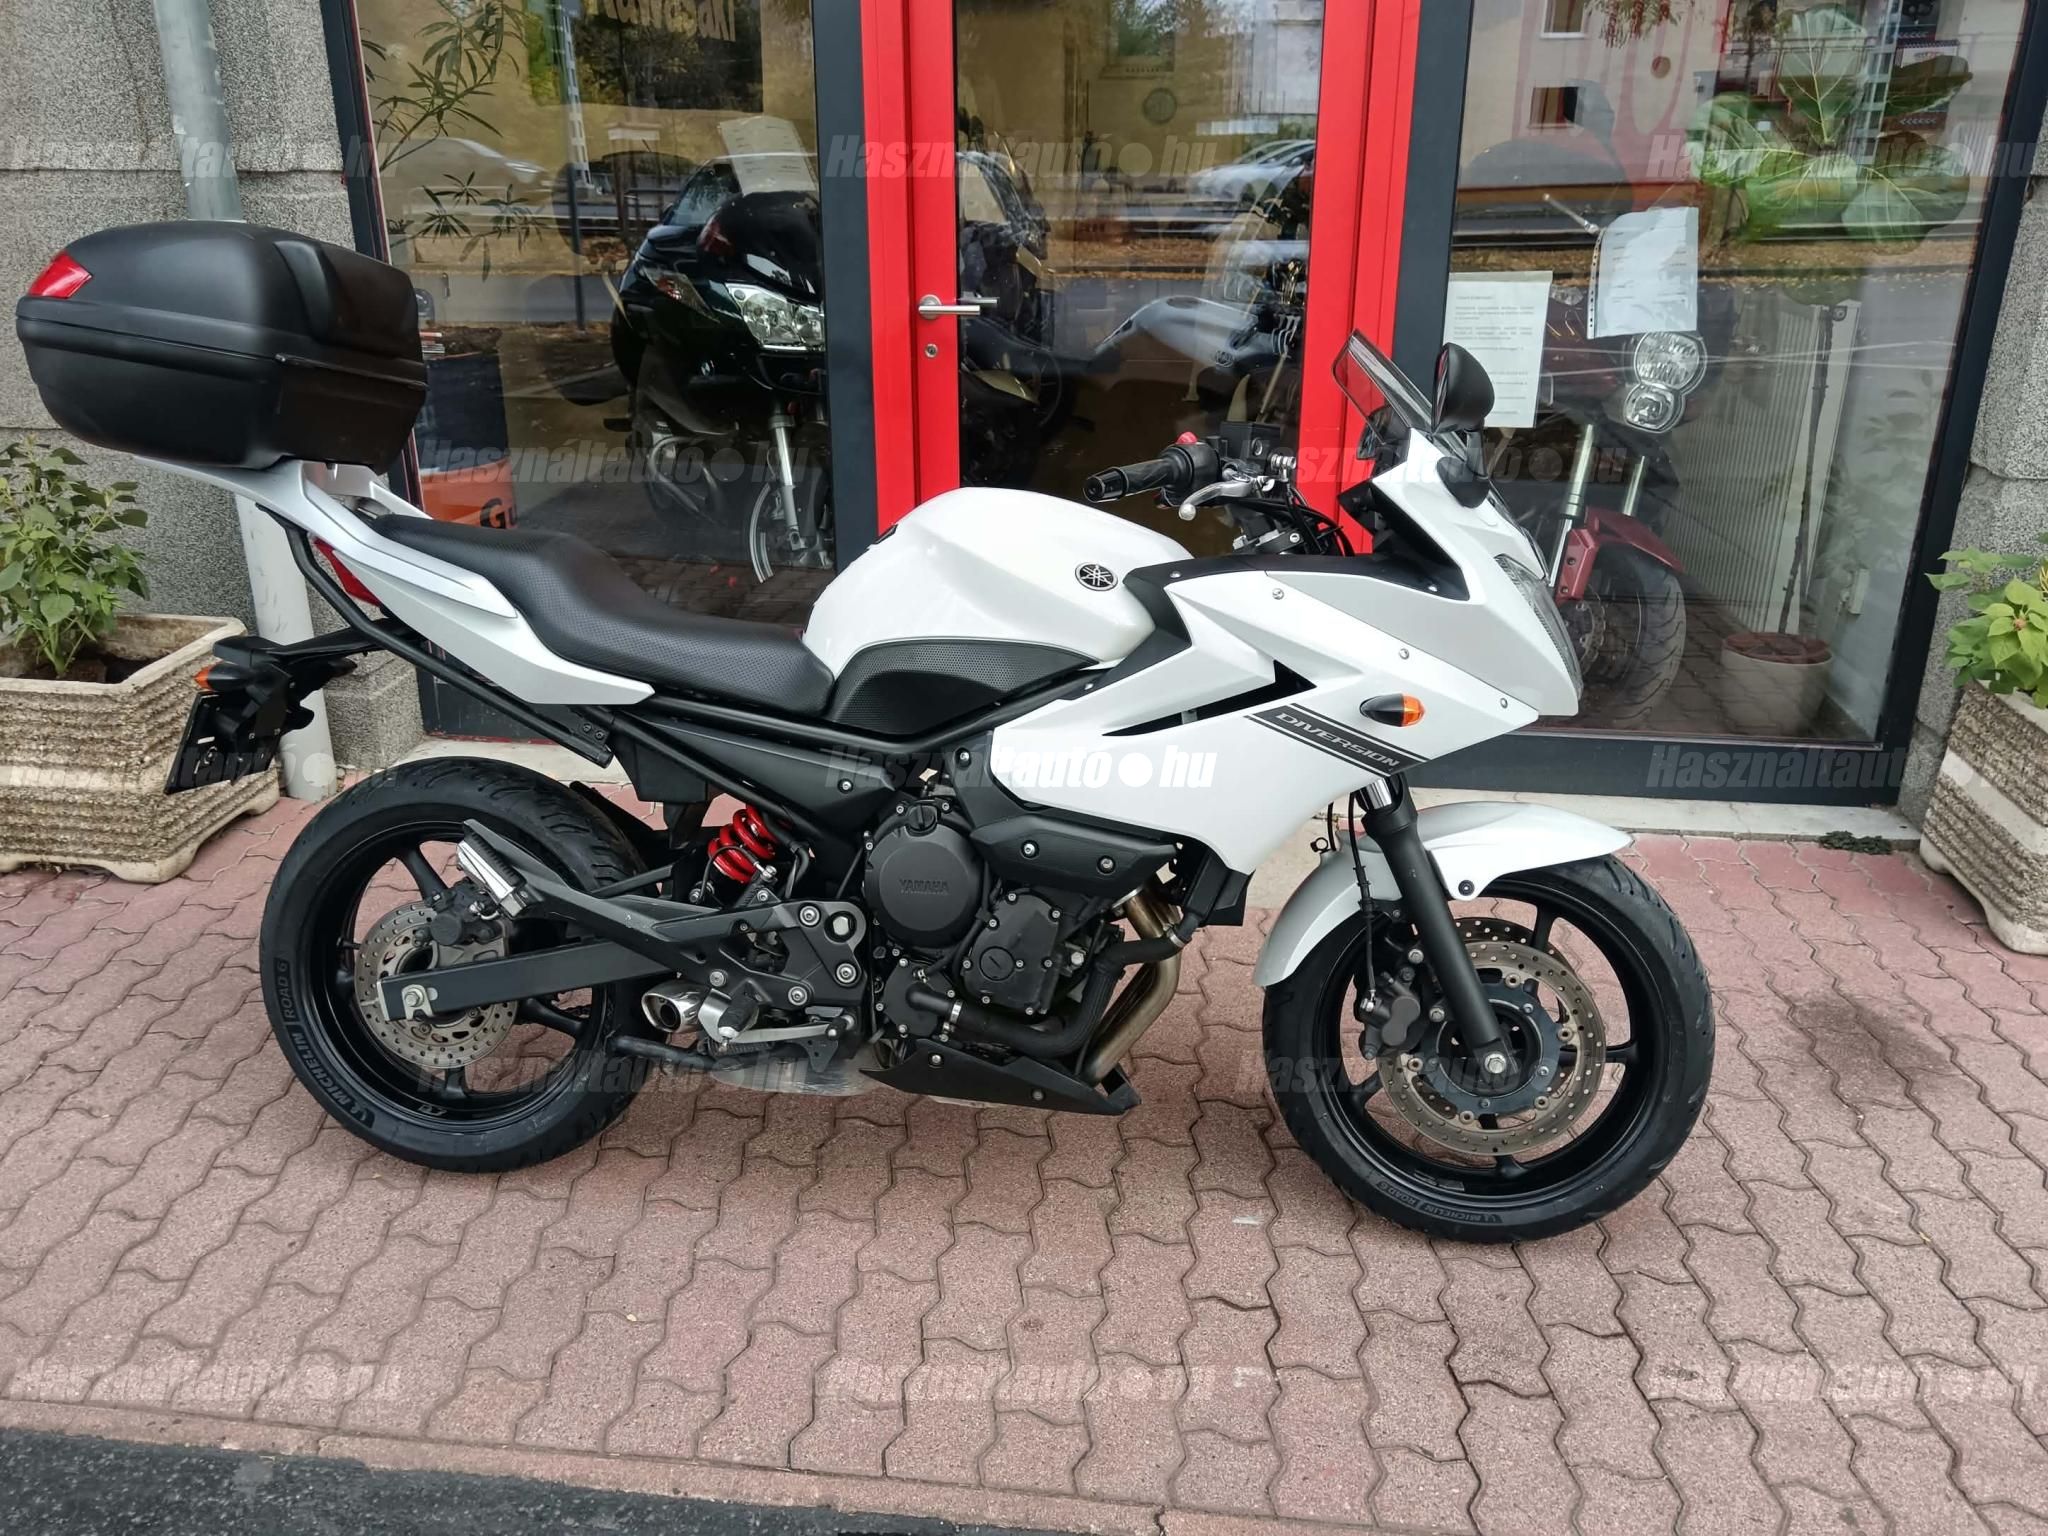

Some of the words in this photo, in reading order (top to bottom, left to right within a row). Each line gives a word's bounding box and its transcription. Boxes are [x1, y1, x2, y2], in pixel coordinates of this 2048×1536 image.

[1275, 713, 1400, 766] DIVERSION
[898, 878, 949, 895] YAMAHA
[277, 977, 297, 1020] ROAD
[292, 1032, 350, 1106] MICHELIN
